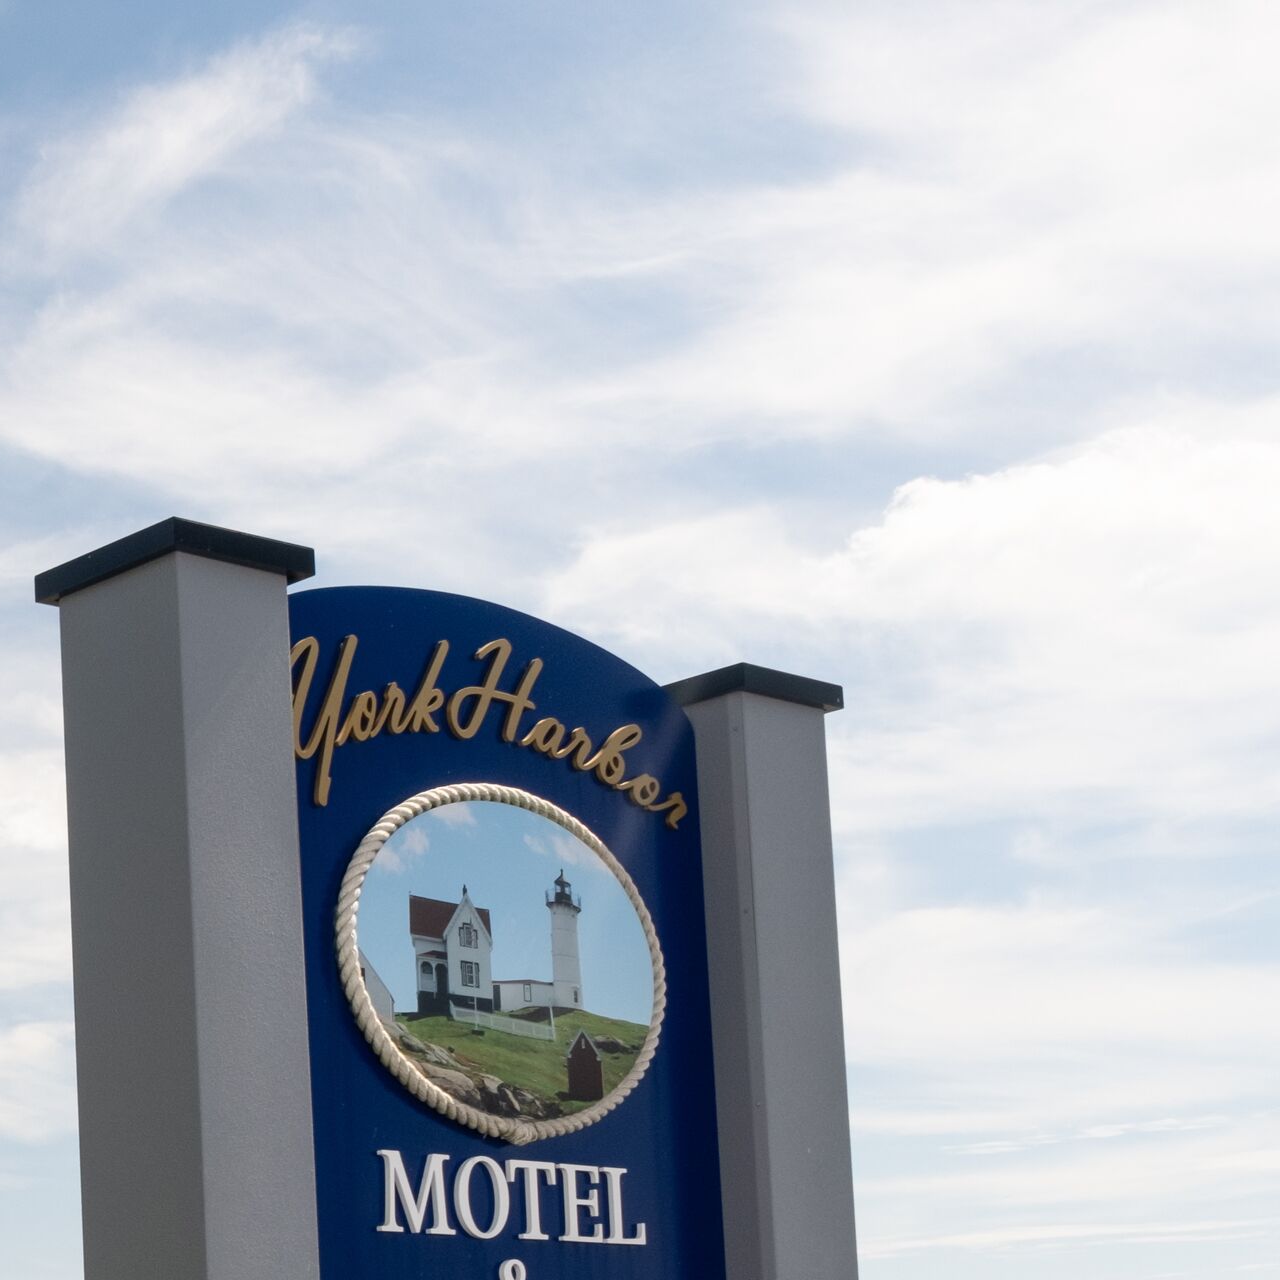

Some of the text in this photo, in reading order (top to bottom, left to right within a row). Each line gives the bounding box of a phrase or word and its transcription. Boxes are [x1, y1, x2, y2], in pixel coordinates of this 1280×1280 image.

[290, 634, 689, 831] York Harbor
[376, 1149, 646, 1246] MOTEL
